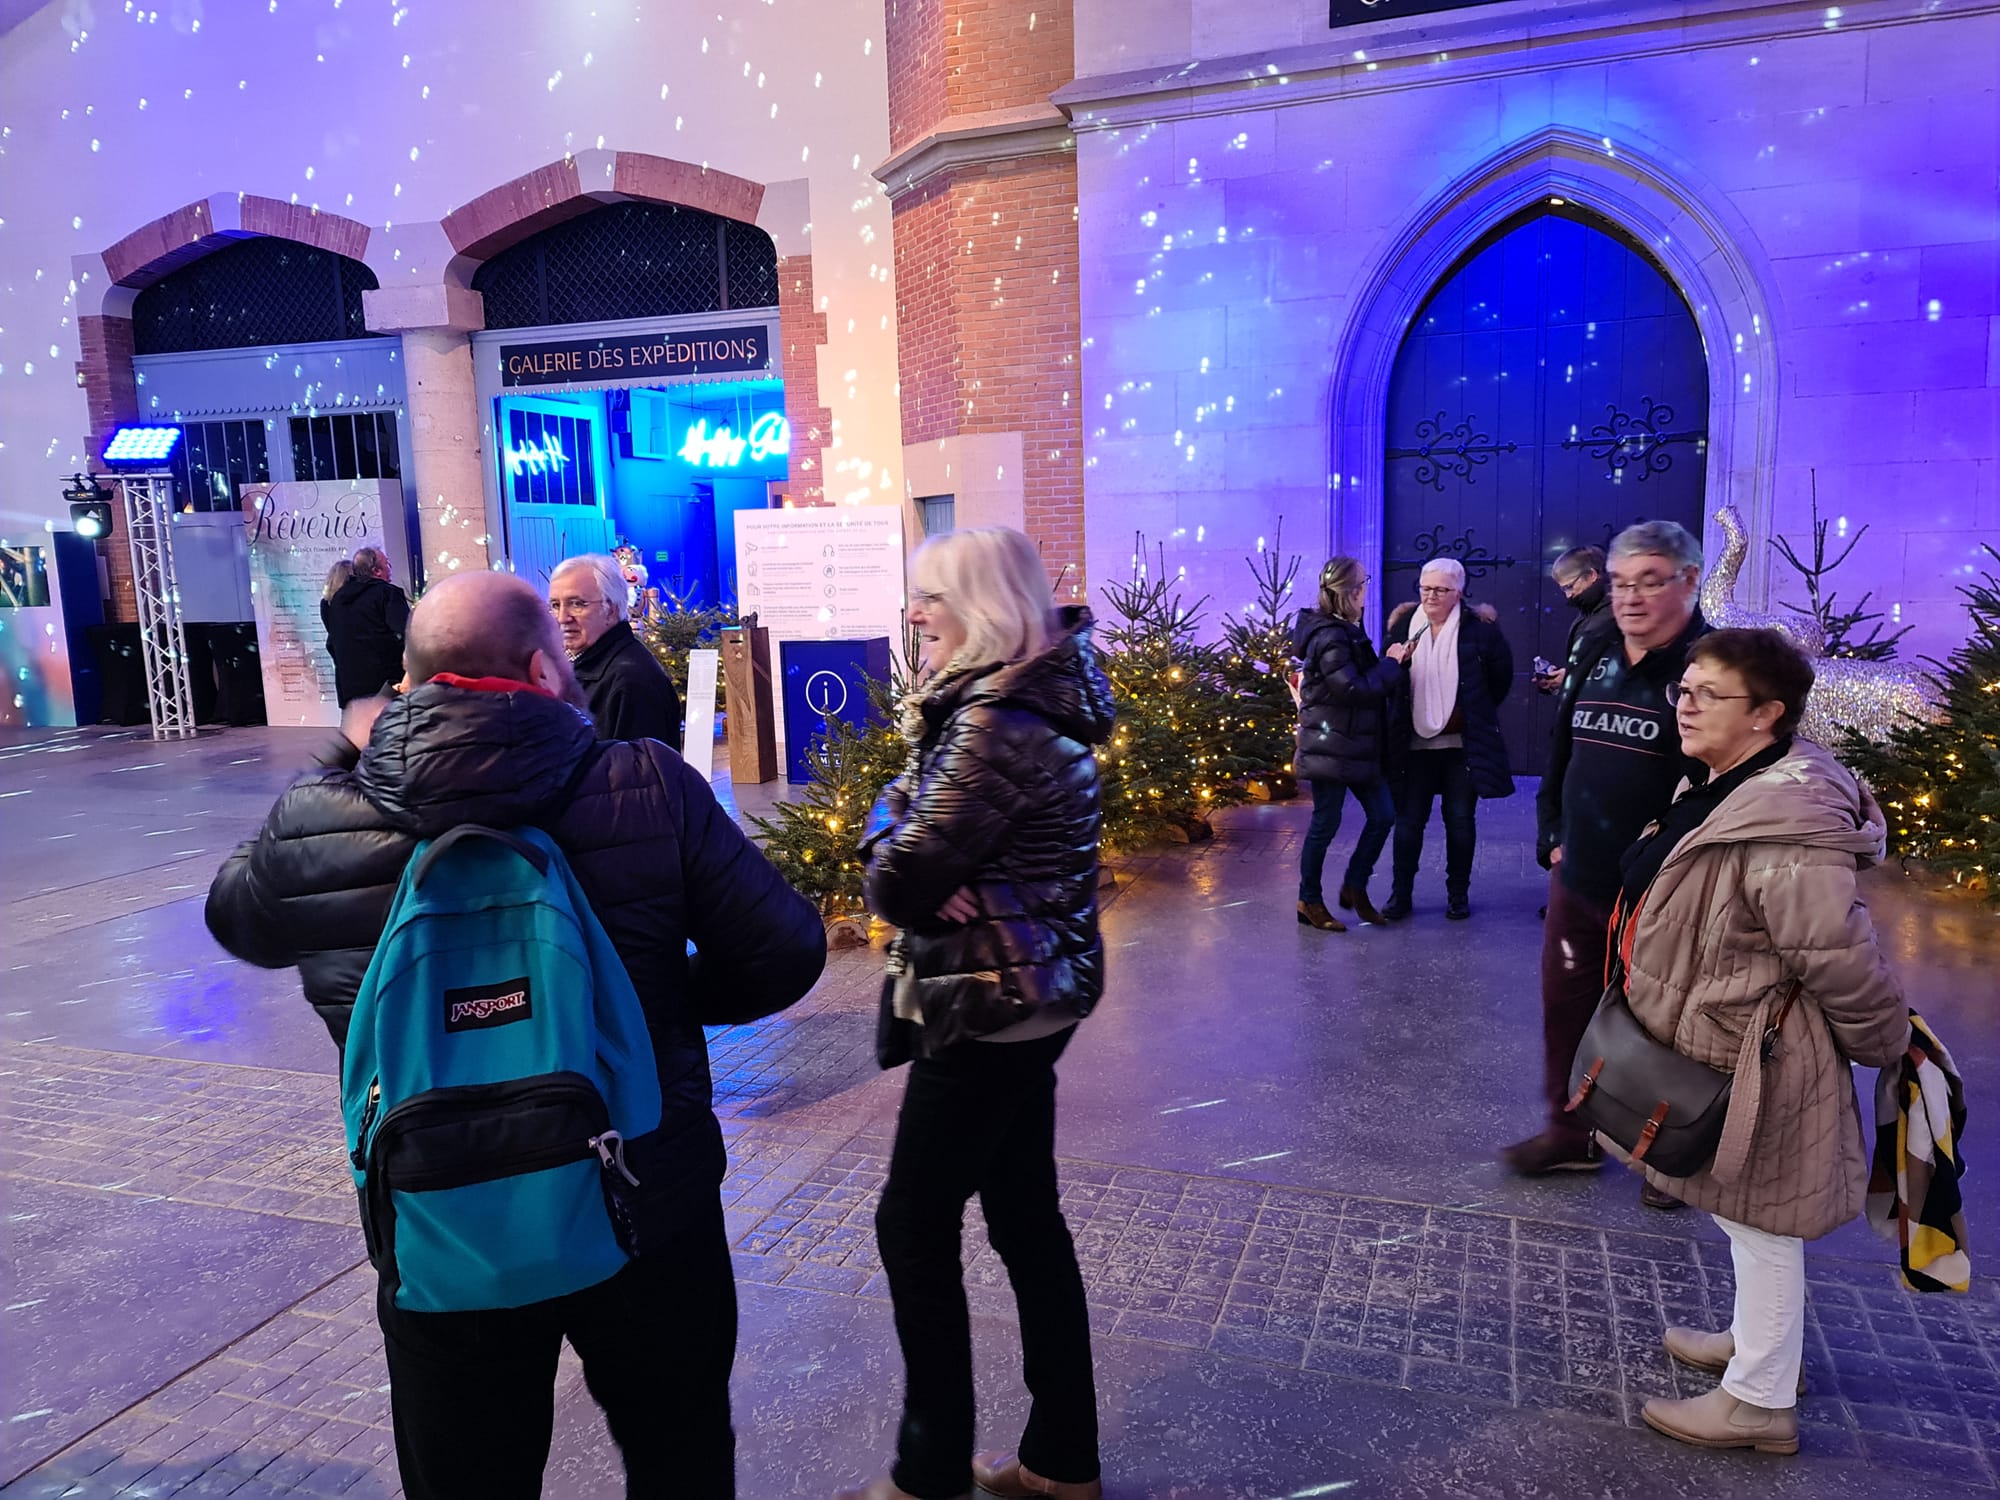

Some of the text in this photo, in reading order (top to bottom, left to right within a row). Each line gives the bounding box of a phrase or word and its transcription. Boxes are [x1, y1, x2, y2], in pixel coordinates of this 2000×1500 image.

[509, 337, 758, 374] GALERIE DES EXPEDITIONS
[241, 486, 380, 546] Rêveries
[1572, 710, 1660, 740] BLANCO
[451, 991, 525, 1023] JANSPORT
